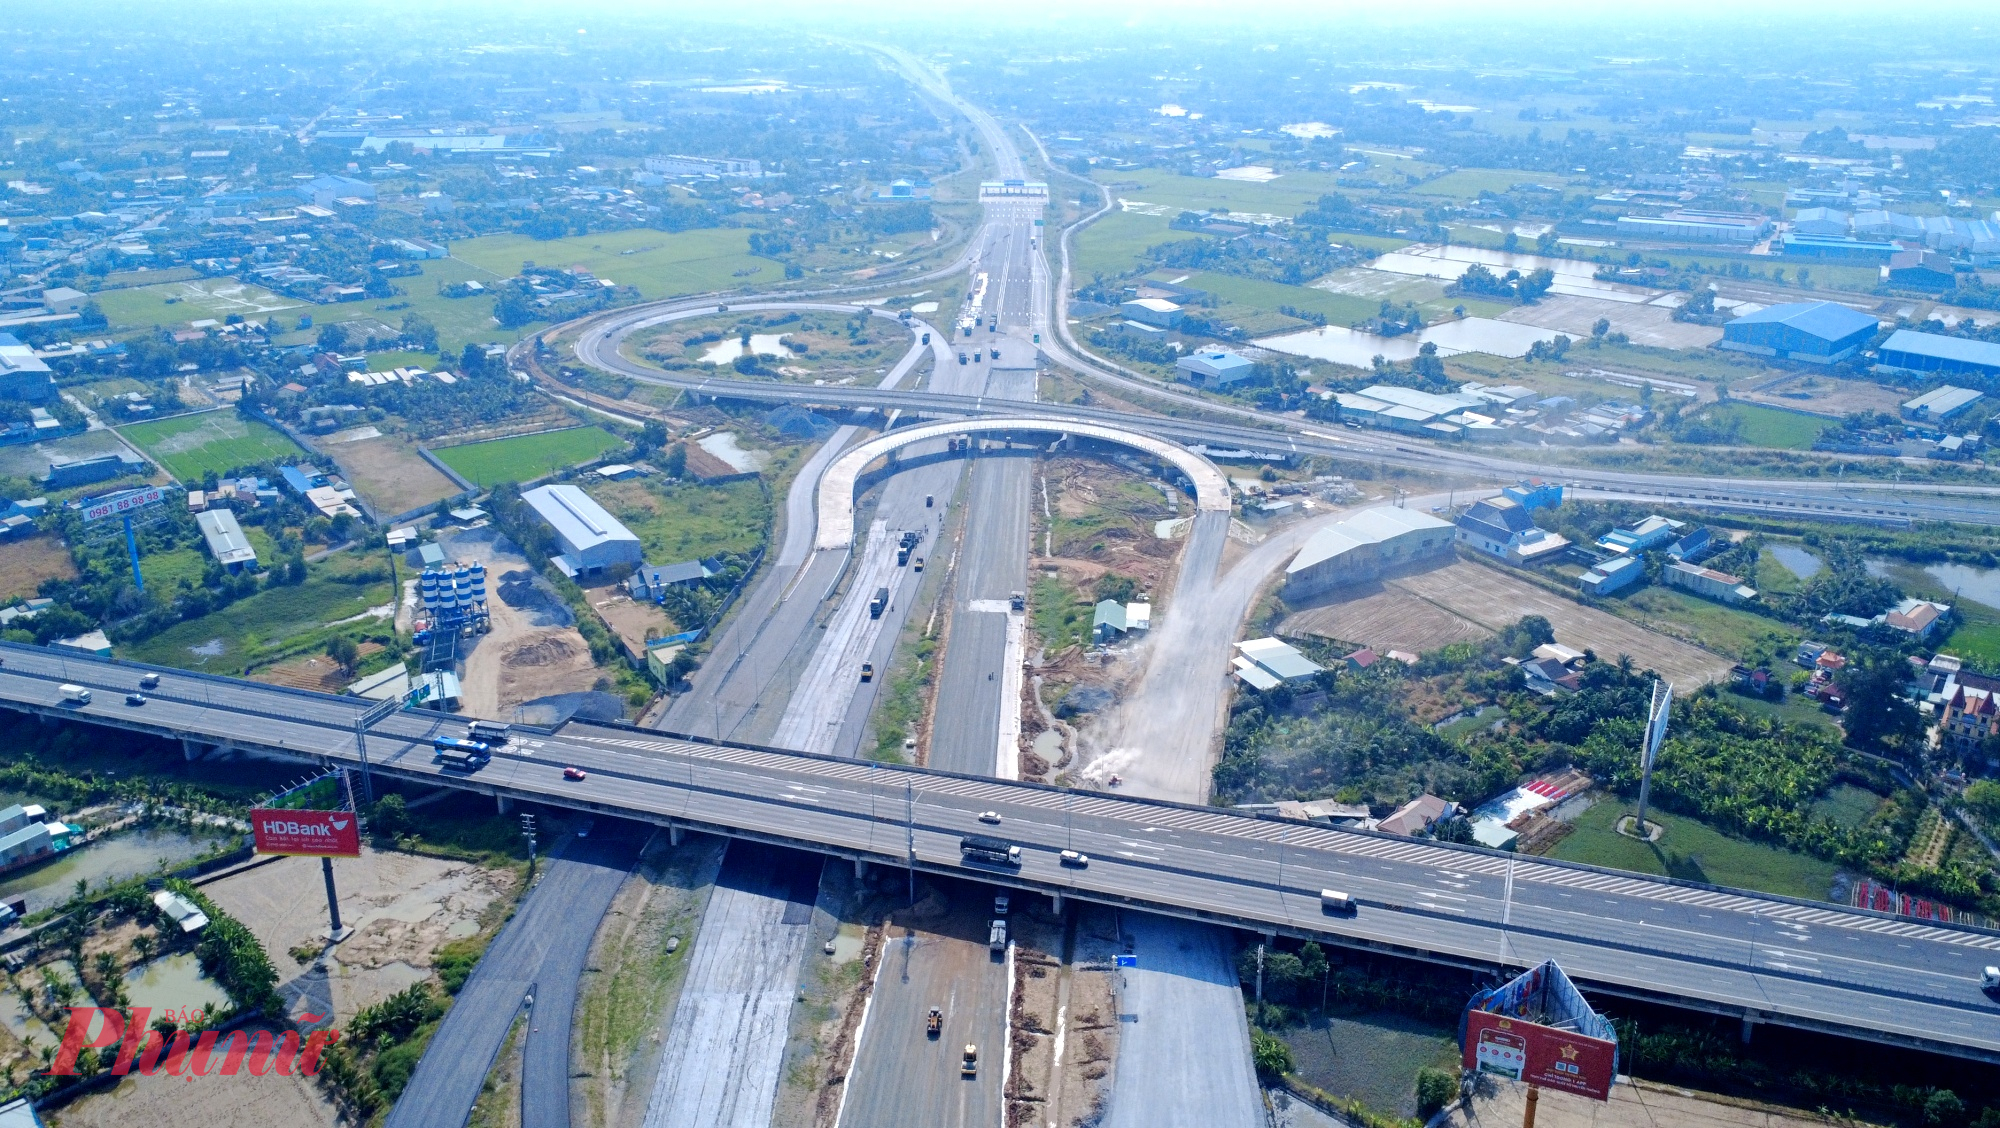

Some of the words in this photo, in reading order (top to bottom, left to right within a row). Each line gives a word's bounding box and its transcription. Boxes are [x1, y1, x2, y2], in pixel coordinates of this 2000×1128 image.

[117, 500, 130, 510] 88
[132, 496, 144, 506] 98
[146, 492, 158, 502] 98
[263, 821, 331, 836] HDBank
